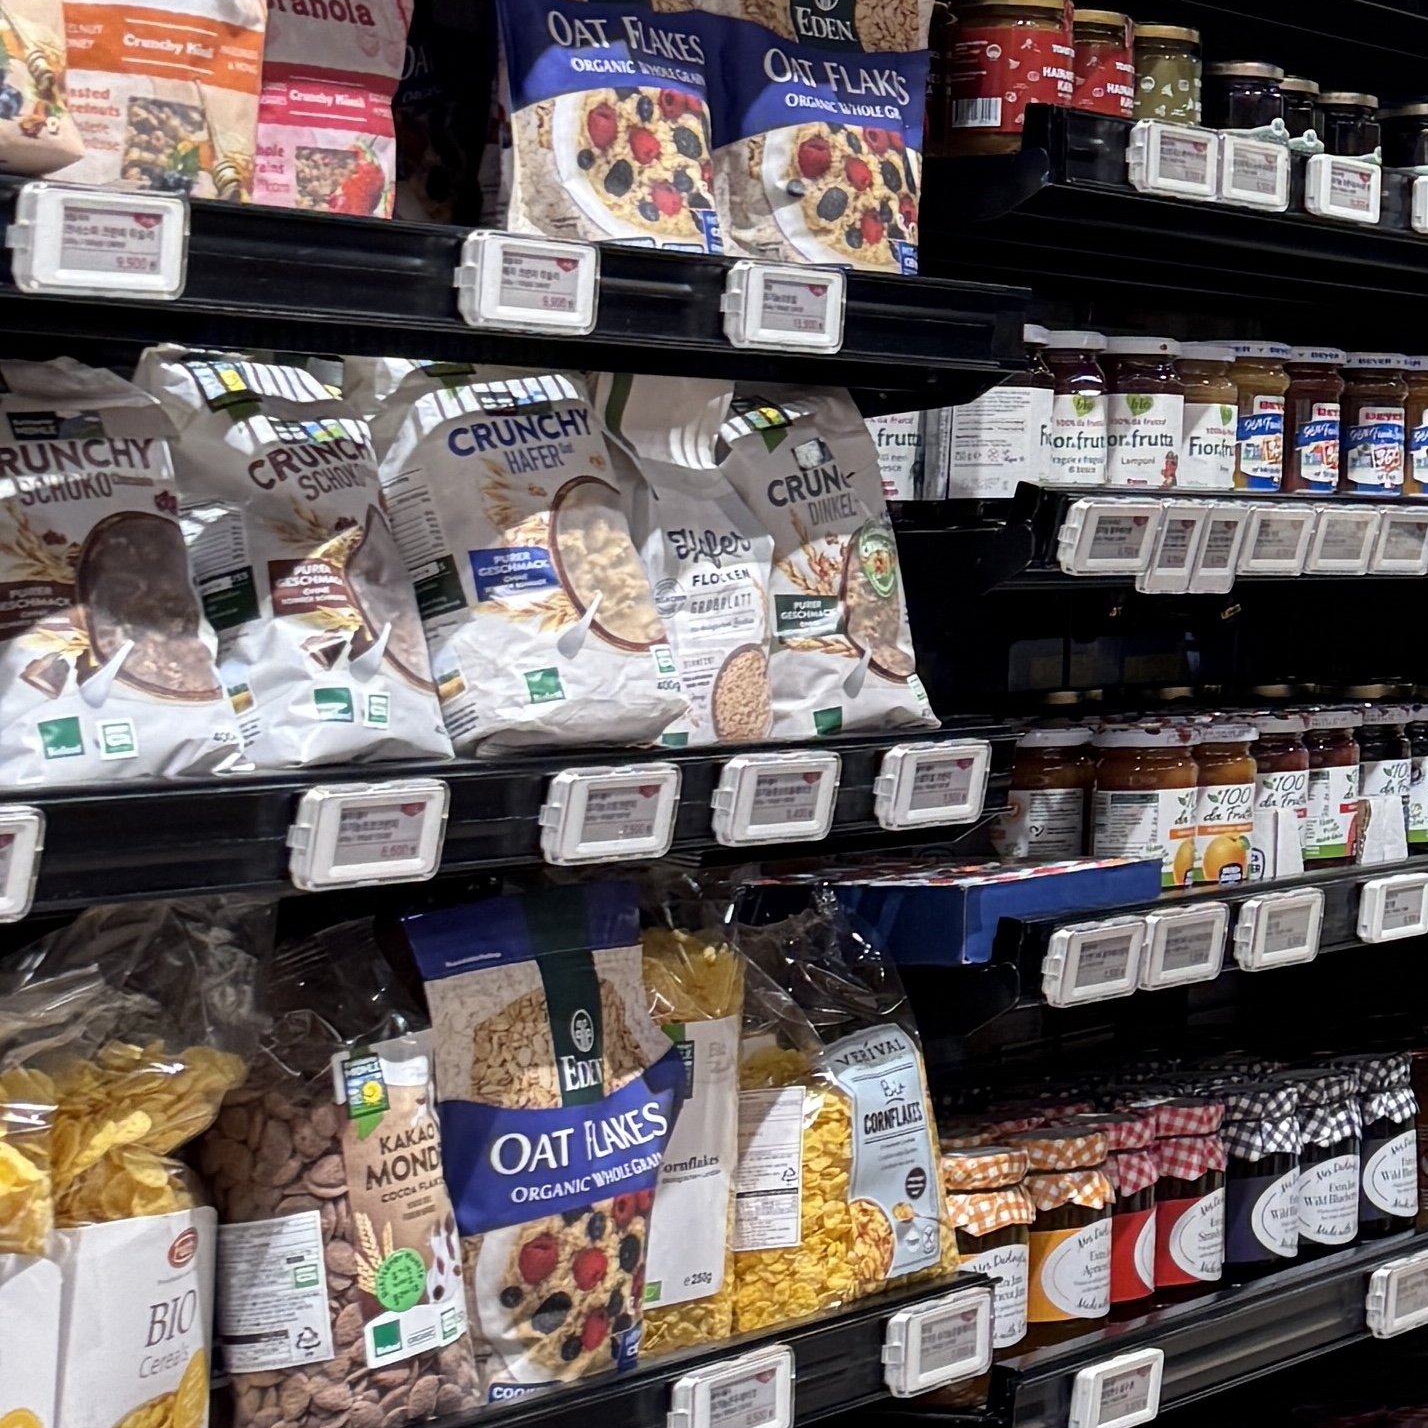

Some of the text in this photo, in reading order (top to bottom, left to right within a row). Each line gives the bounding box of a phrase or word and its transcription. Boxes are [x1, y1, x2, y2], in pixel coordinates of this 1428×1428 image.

[547, 10, 706, 66] OAT FLAKES
[793, 5, 855, 42] EDEN
[122, 32, 186, 57] Crunchy
[570, 56, 636, 75] ORGANIC
[764, 48, 818, 89] OAT
[784, 91, 882, 119] ORGANIC WHOLE
[256, 144, 286, 158] hole
[254, 162, 285, 176] rains
[448, 408, 592, 458] CRUNCHY
[247, 428, 375, 490] CRUNCH
[506, 445, 565, 476] HAFER
[20, 472, 113, 506] SCHOKO
[808, 495, 858, 527] DINKEL
[691, 567, 752, 588] FLOCKEN
[863, 1101, 924, 1136] CORNFLAKES
[379, 1123, 437, 1157] KAKAO
[489, 1101, 668, 1176] OAT FLAKES
[365, 1147, 443, 1192] MOND
[510, 1175, 591, 1205] ORGANIC
[591, 1166, 634, 1189] WHOLE
[380, 1186, 415, 1204] COCOA
[145, 1289, 198, 1348] BIO
[138, 1339, 190, 1380] Cereals
